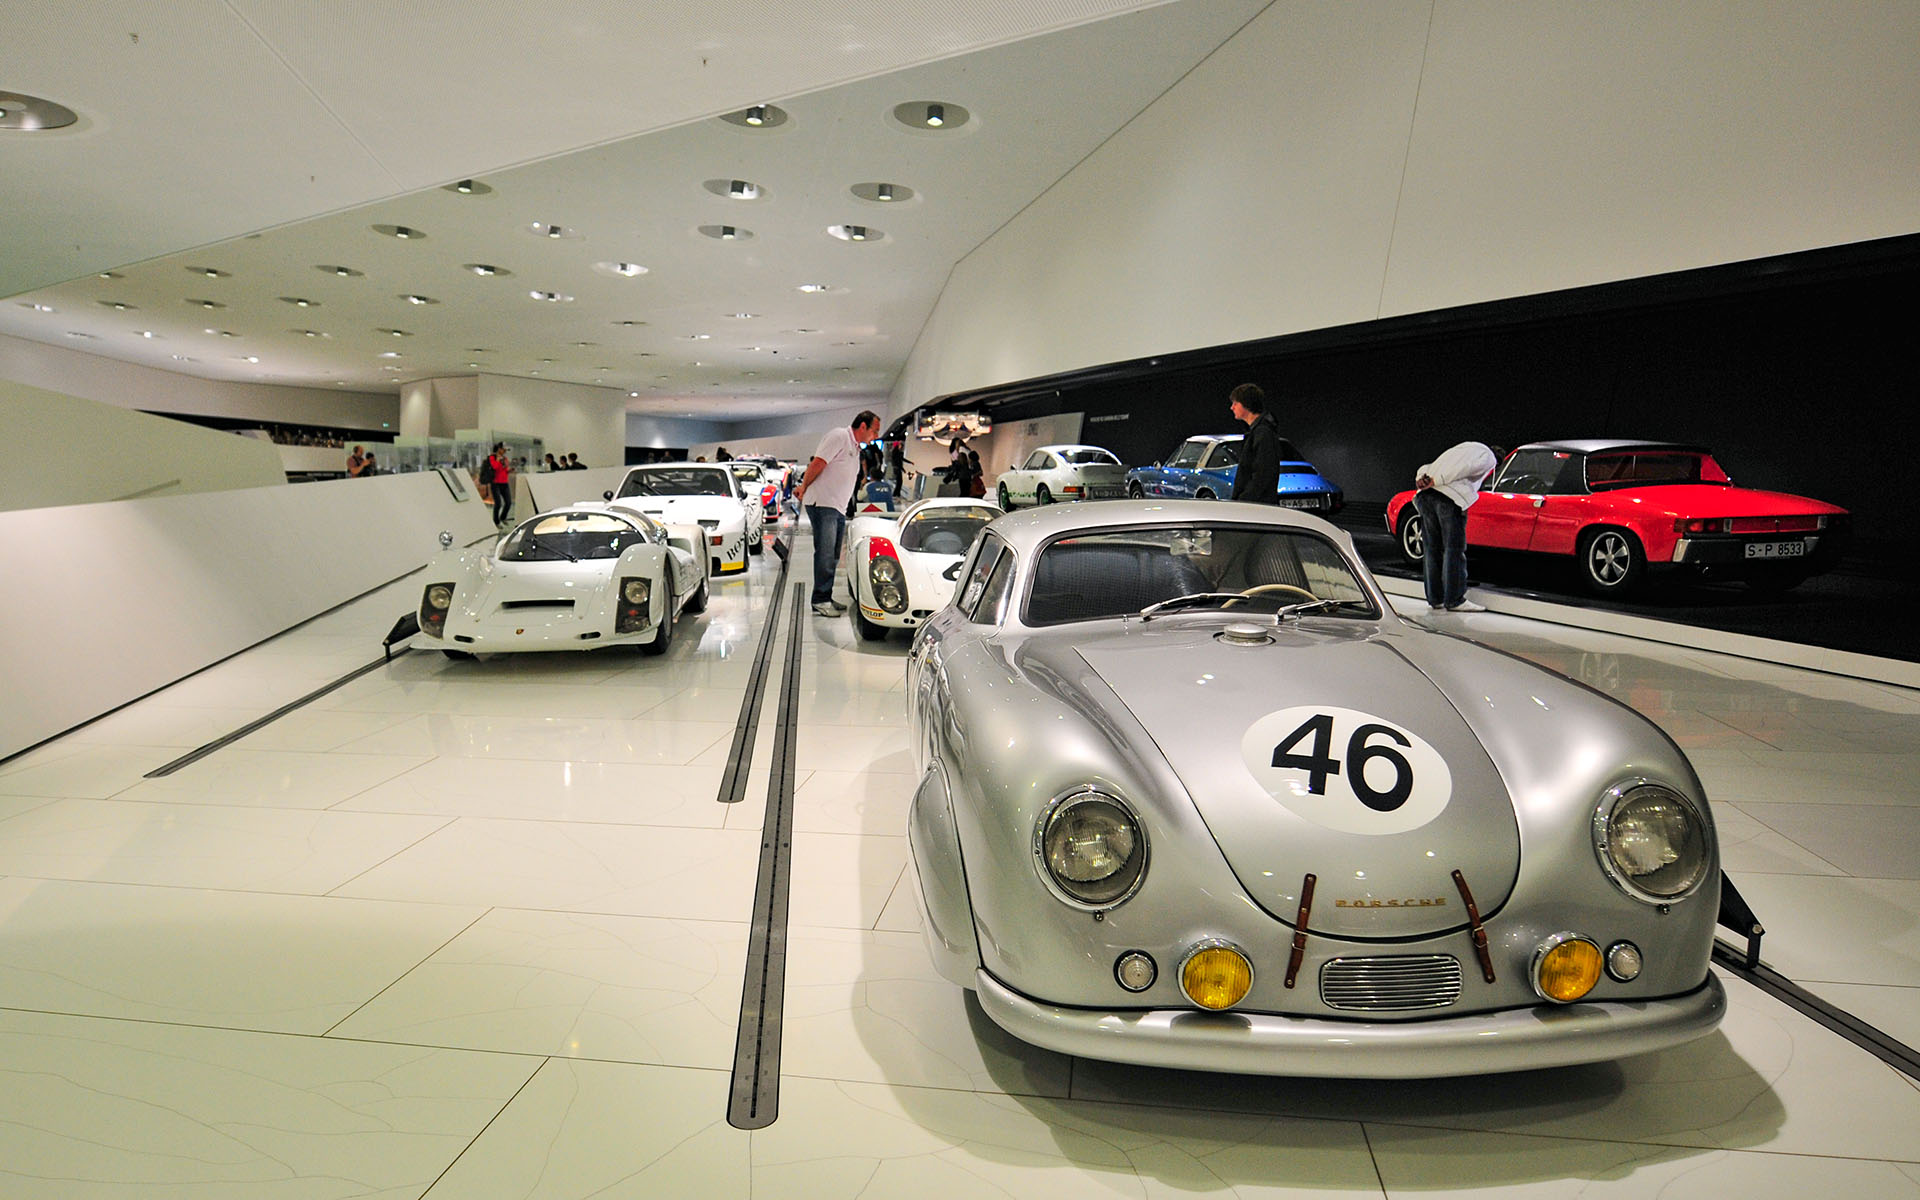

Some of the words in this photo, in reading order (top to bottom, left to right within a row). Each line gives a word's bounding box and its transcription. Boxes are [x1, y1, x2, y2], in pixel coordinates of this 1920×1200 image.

[1778, 543, 1802, 555] 8533
[1270, 713, 1414, 812] 46
[1335, 897, 1447, 908] PORSCHE
